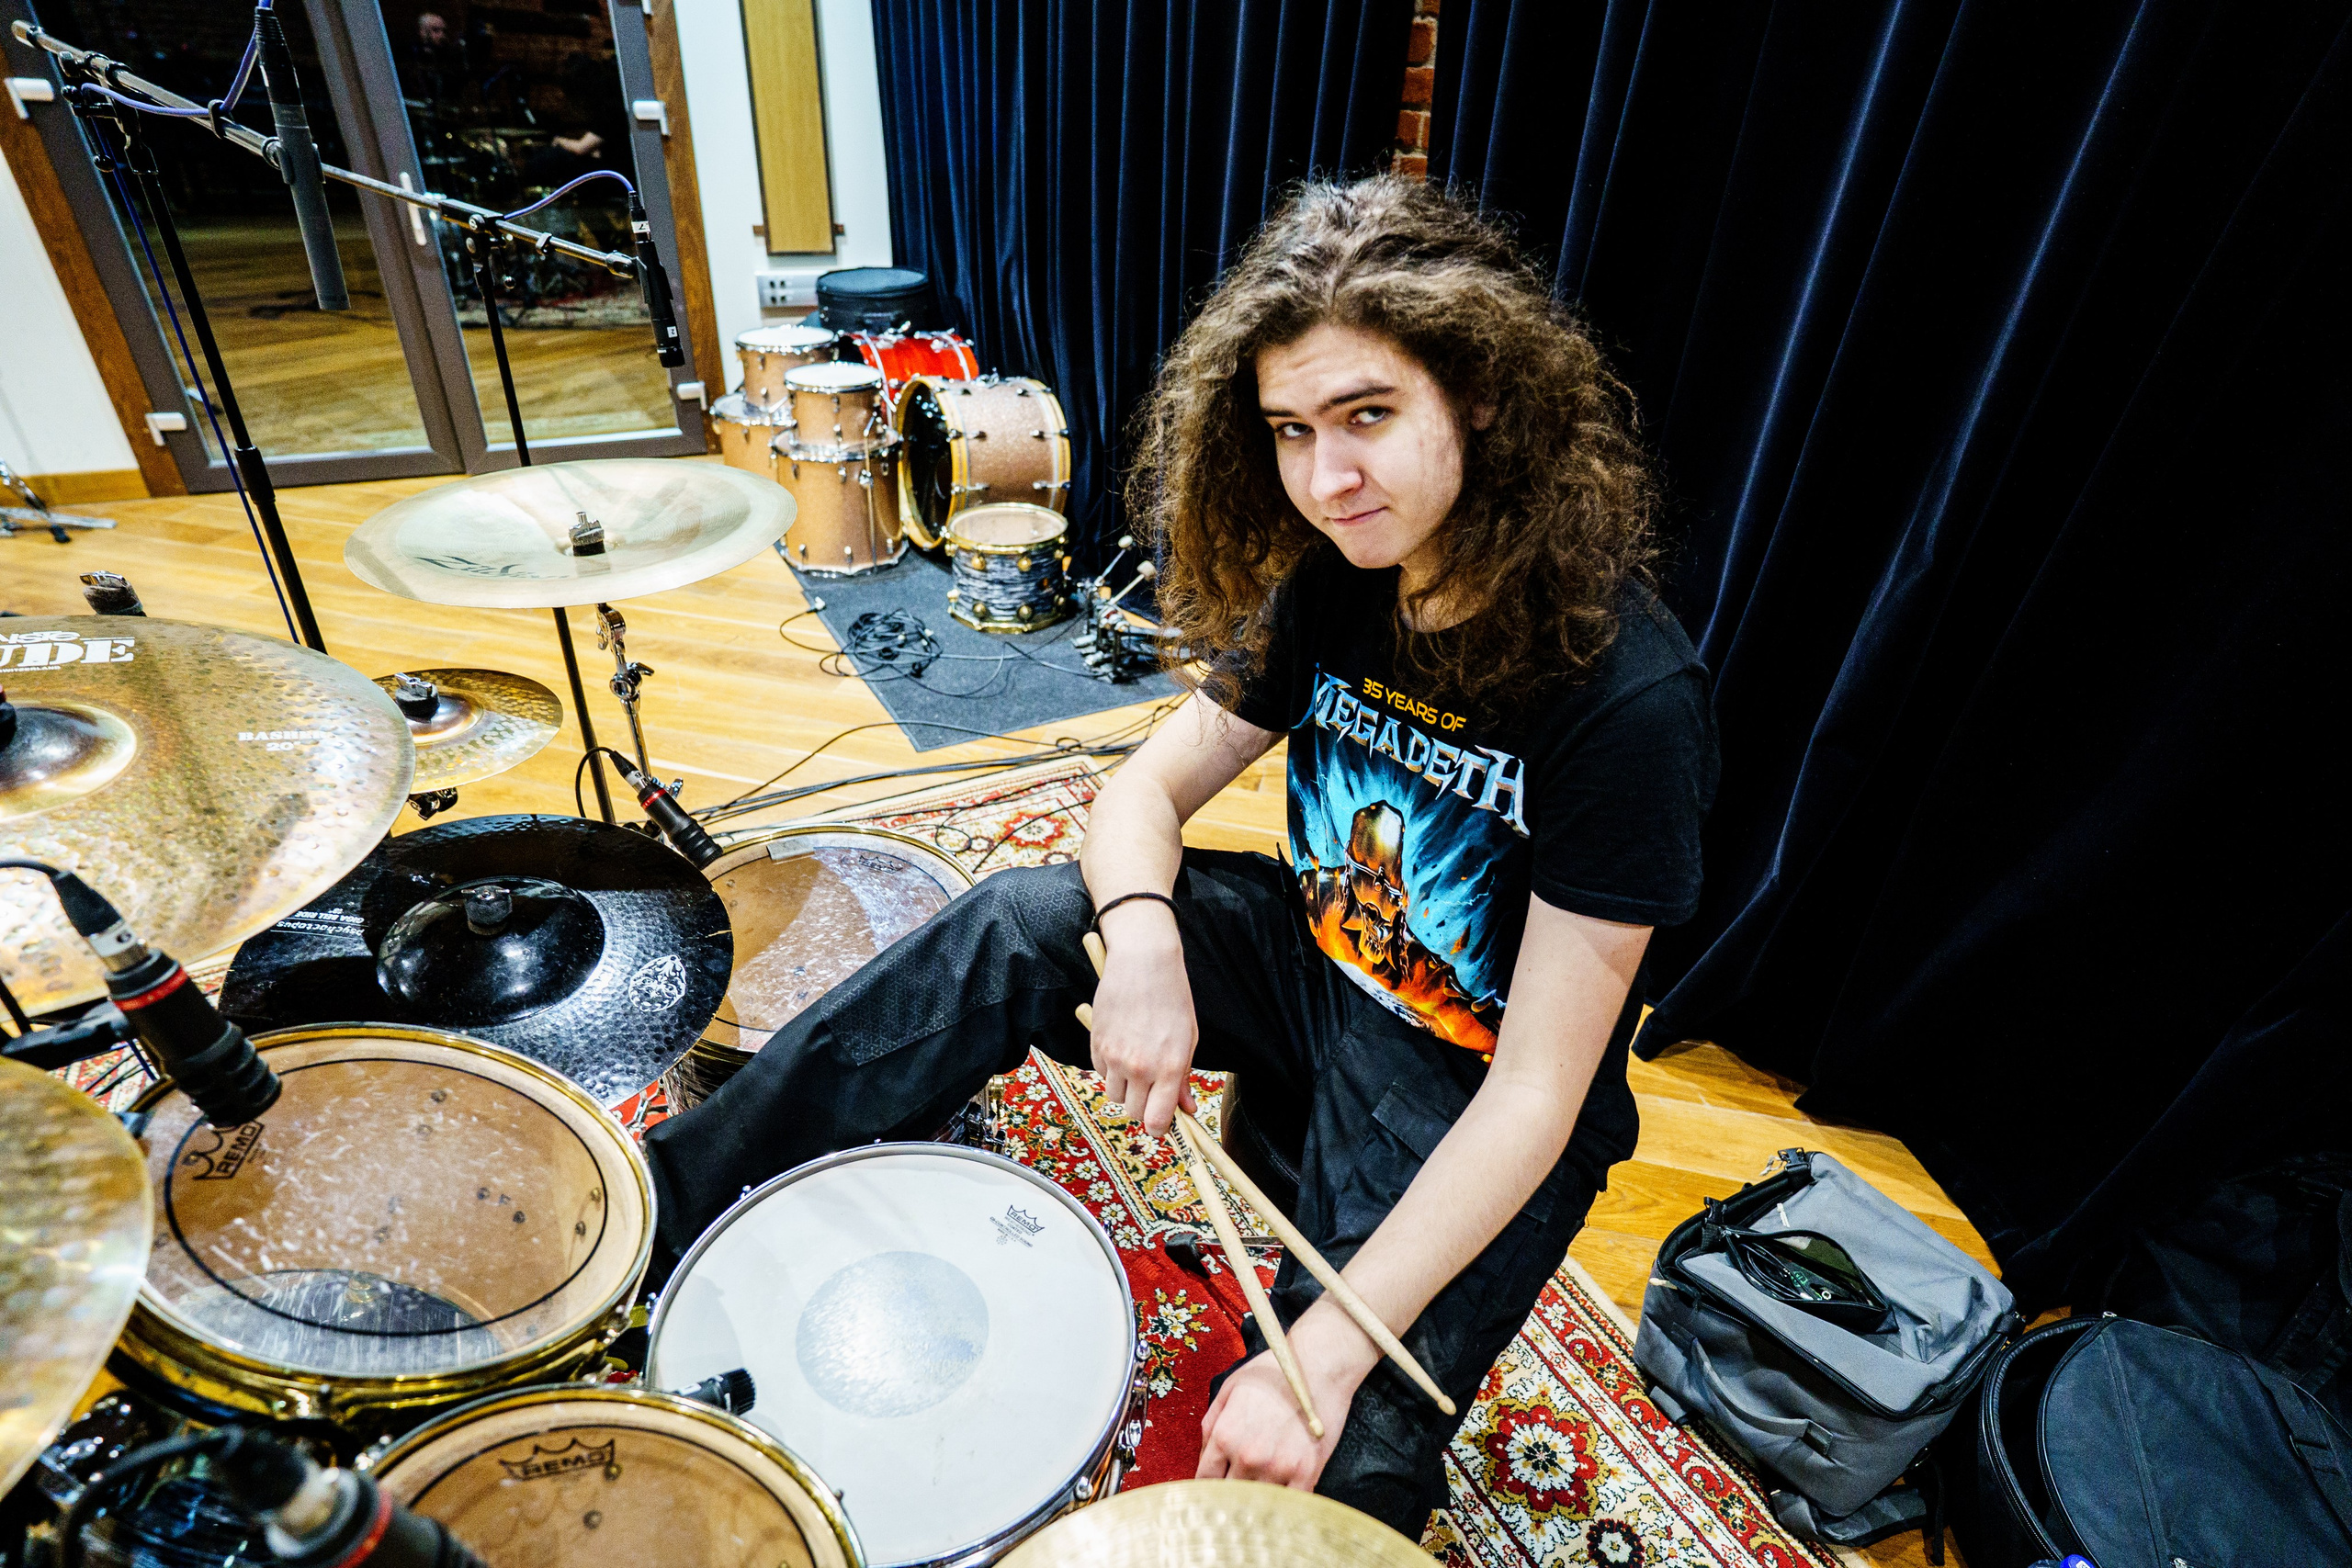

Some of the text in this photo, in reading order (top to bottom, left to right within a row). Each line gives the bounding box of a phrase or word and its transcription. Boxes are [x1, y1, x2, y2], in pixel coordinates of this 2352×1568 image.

[1363, 677, 1467, 732] 35 YEARS OF
[1291, 662, 1531, 840] MEGADETH
[277, 920, 366, 936] psychoctopus
[294, 910, 365, 924] GIGA BELL RIDE
[215, 1125, 257, 1174] REMO
[1010, 1211, 1039, 1232] REMO
[521, 1451, 605, 1476] REMO
